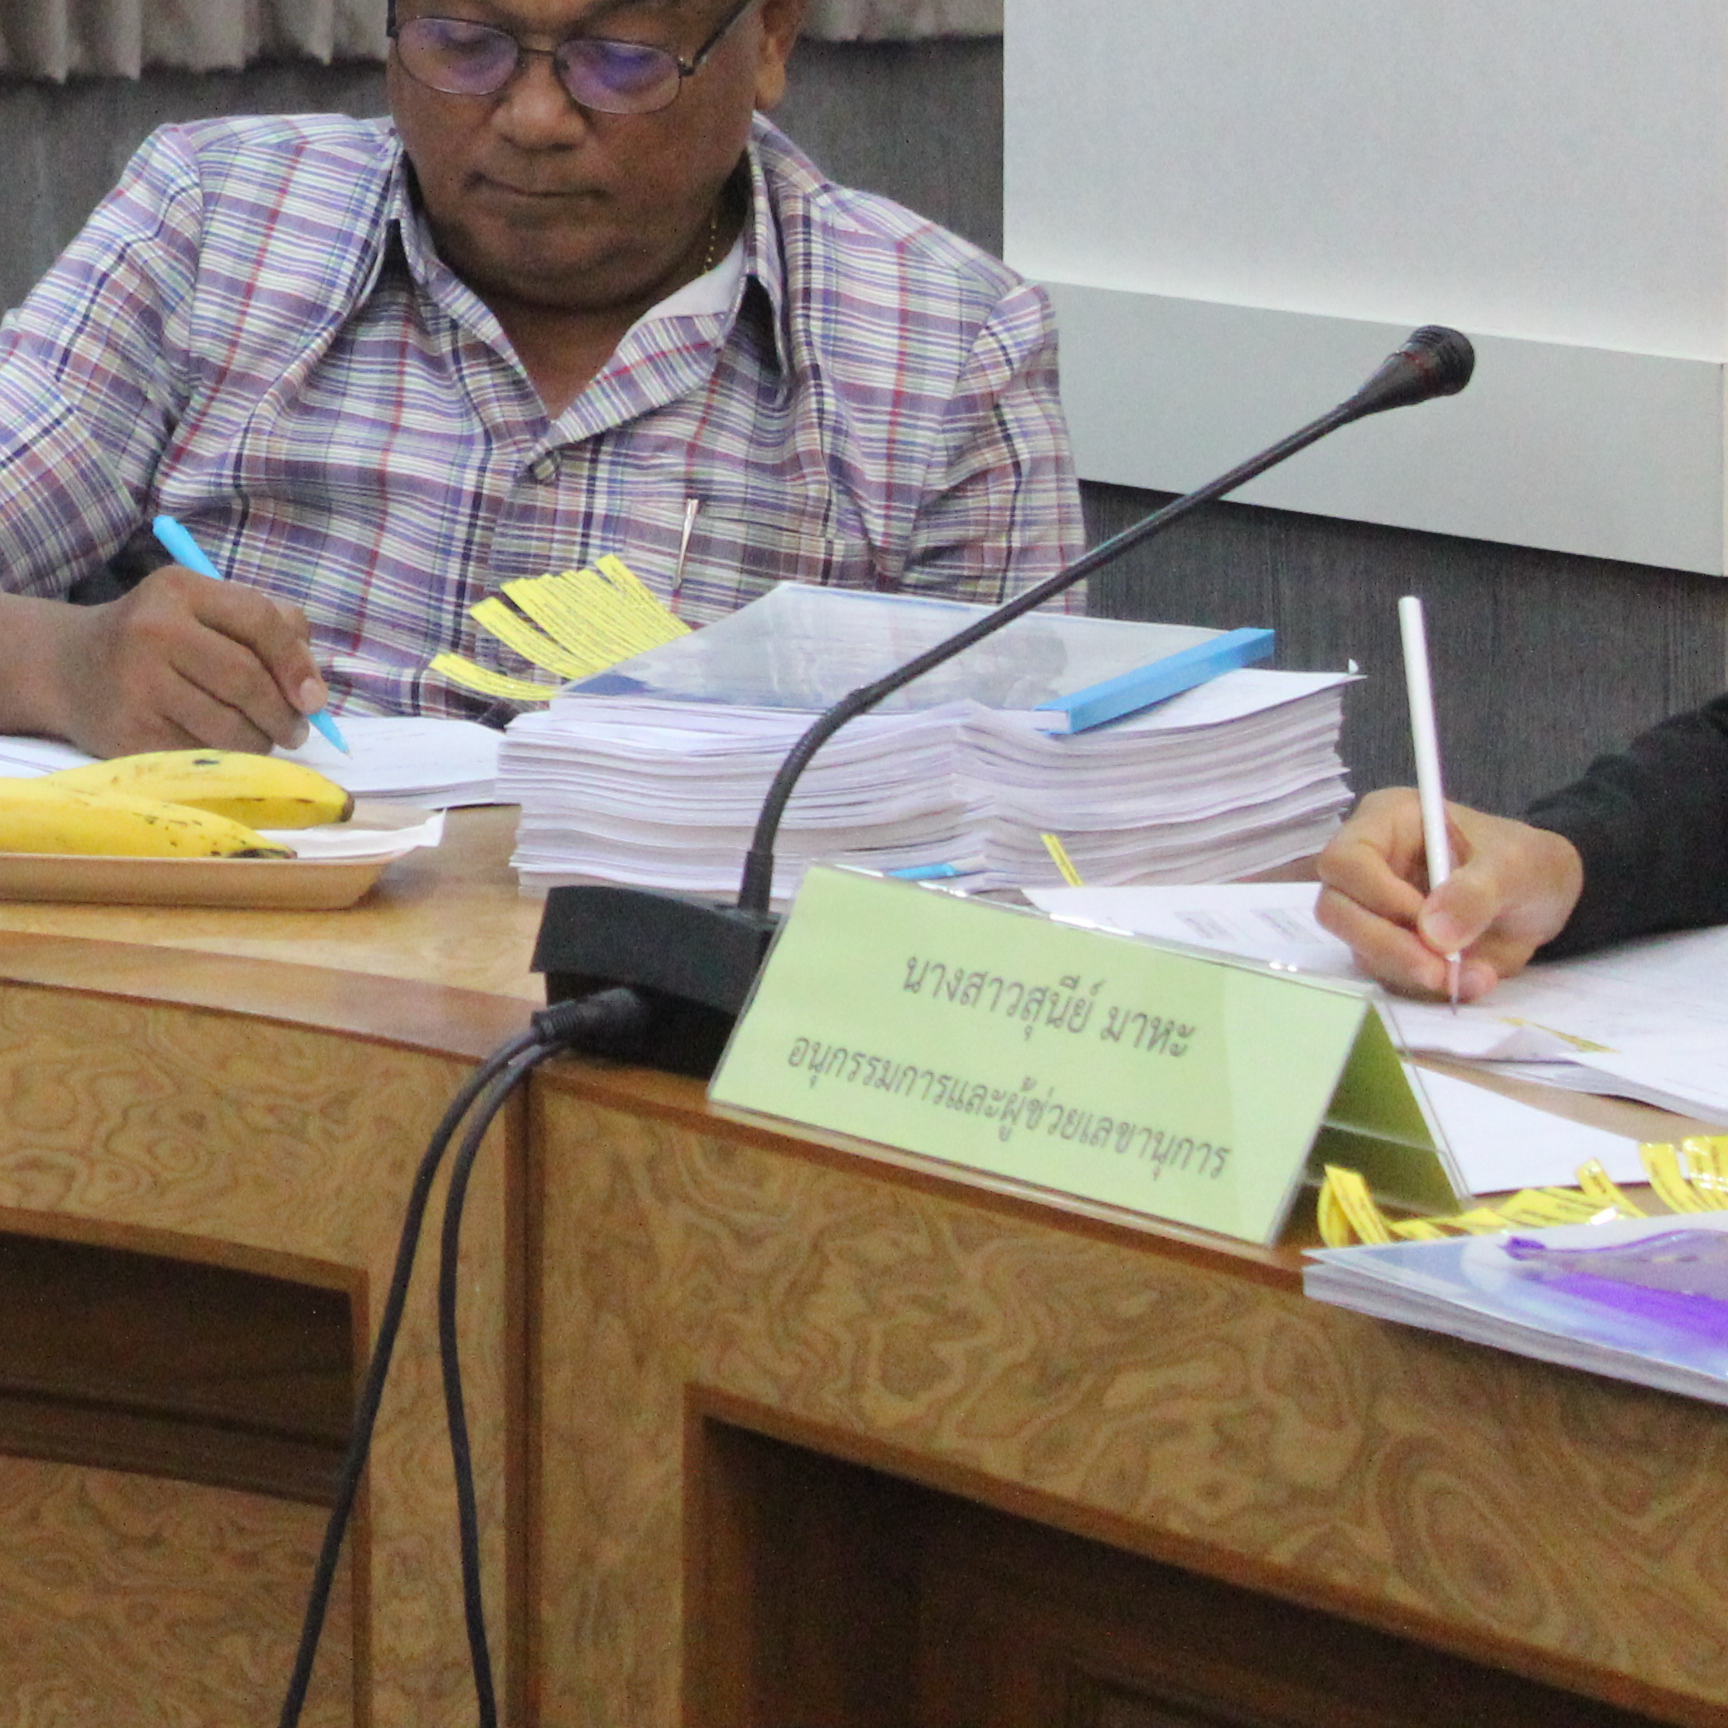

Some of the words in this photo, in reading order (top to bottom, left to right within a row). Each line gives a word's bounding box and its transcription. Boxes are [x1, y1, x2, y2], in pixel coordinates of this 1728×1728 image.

[902, 956, 1107, 1041] นางสาวสุนีย์
[787, 1036, 1232, 1181] อนุกรรมการและผู้ช่วยเลขานุการ
